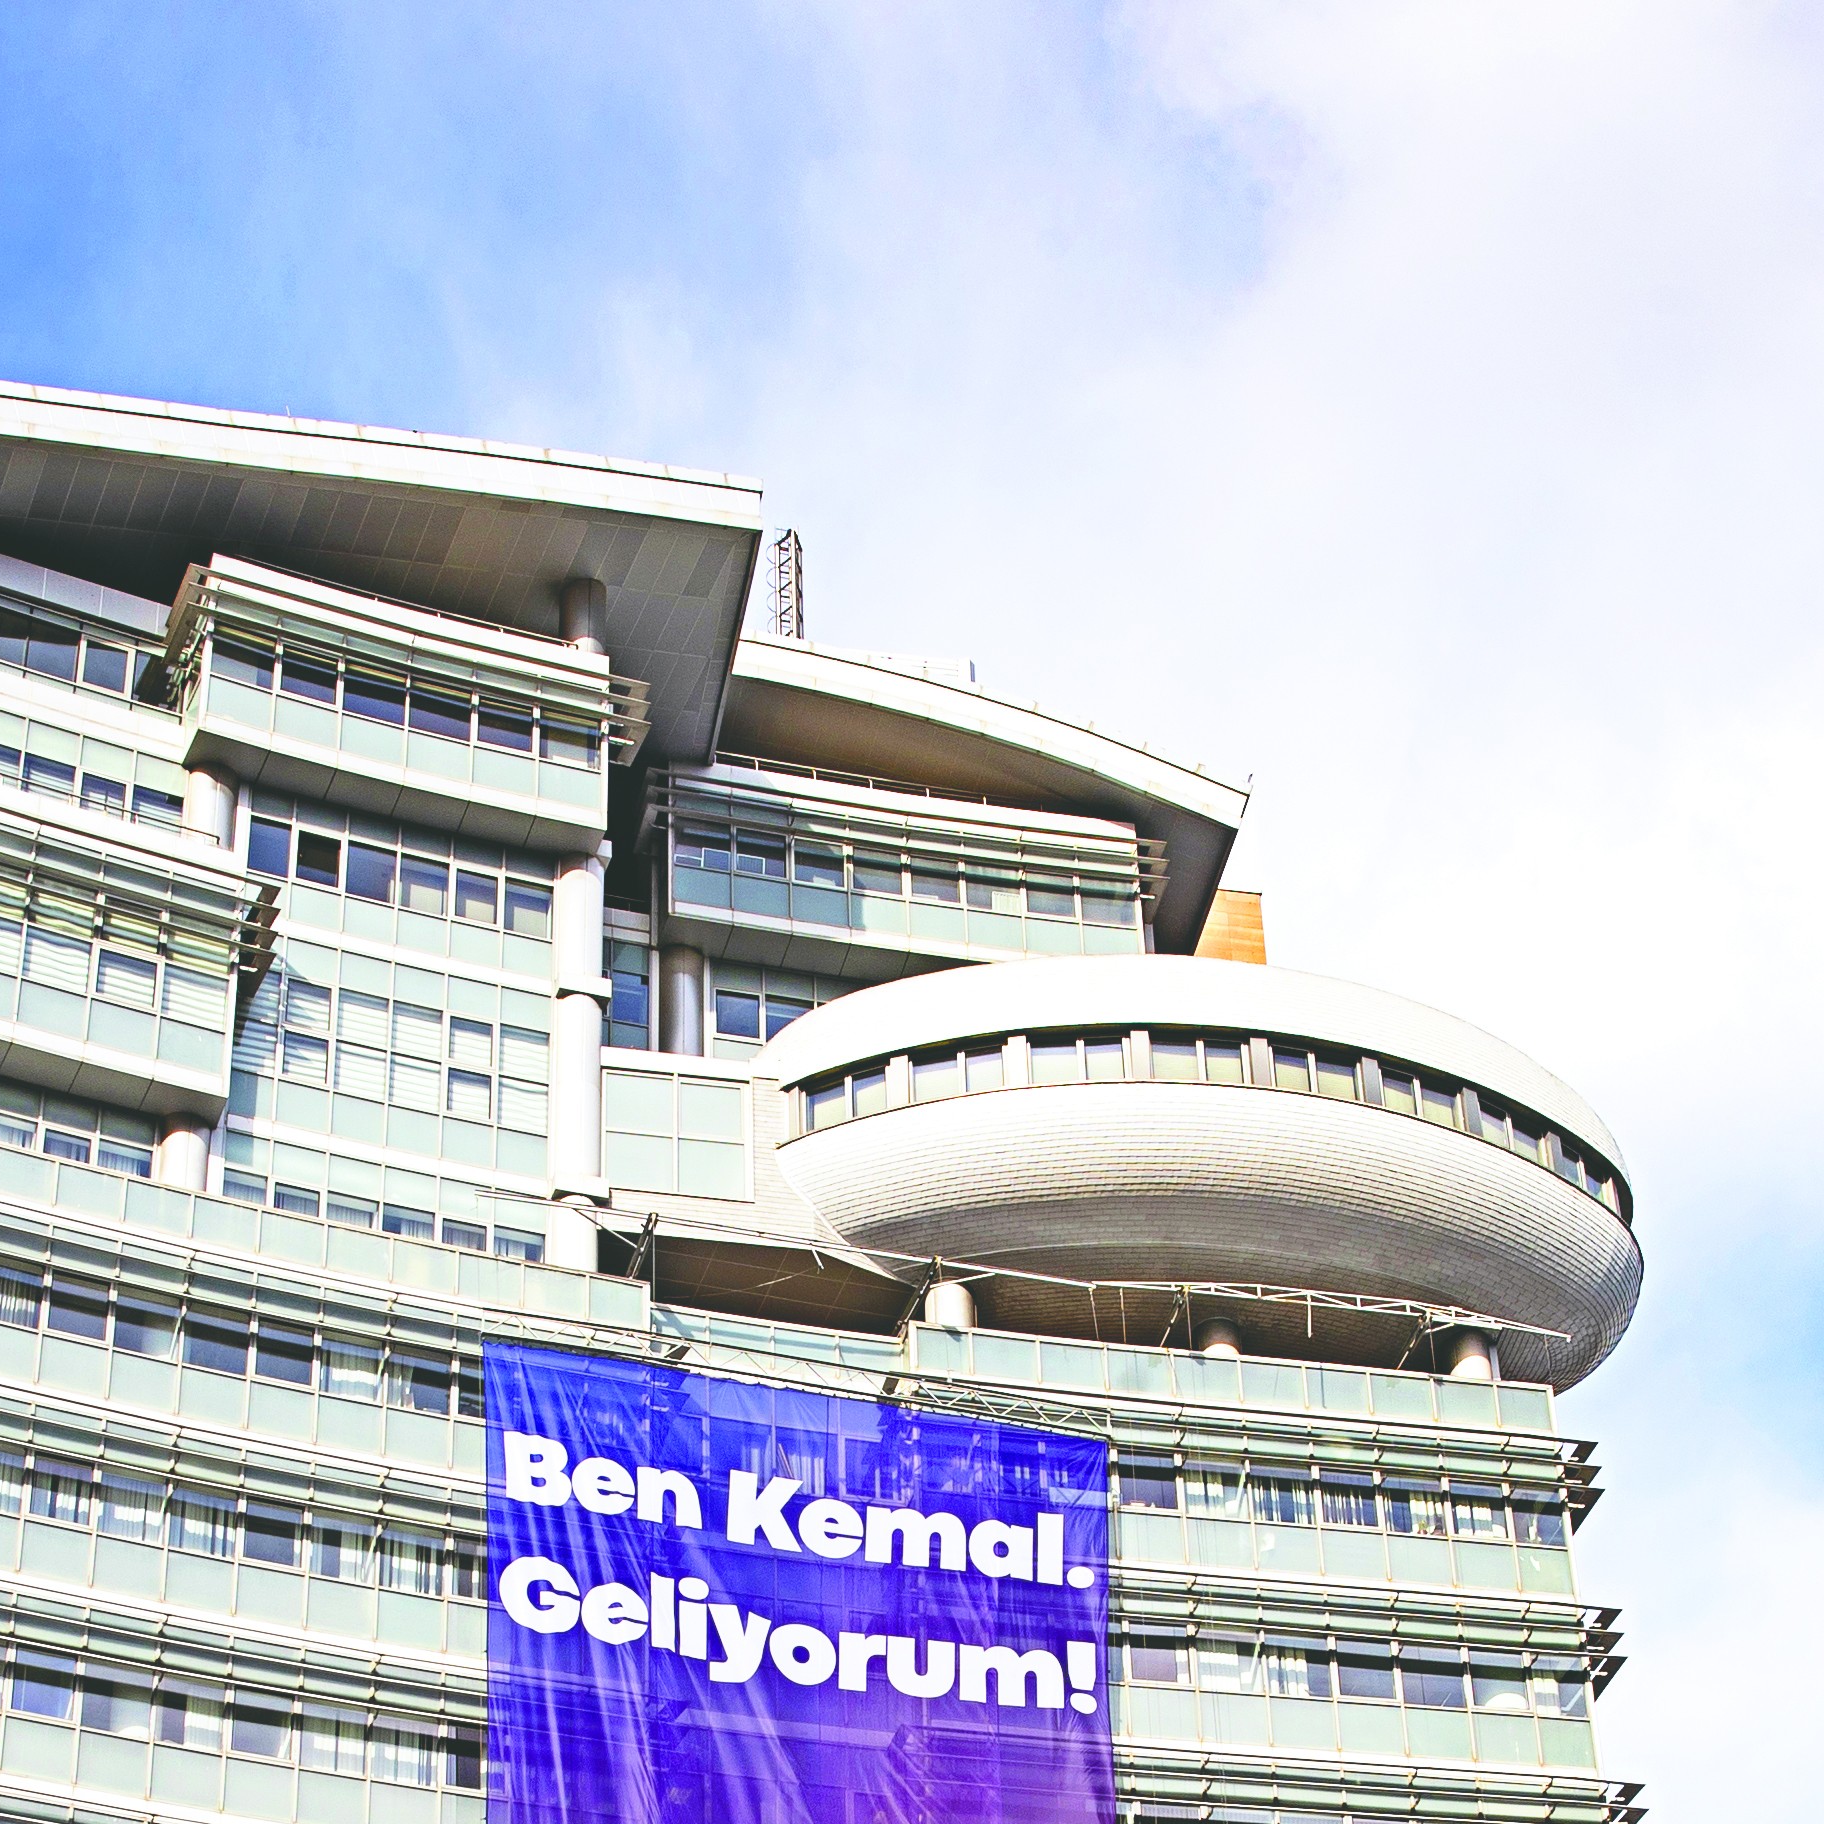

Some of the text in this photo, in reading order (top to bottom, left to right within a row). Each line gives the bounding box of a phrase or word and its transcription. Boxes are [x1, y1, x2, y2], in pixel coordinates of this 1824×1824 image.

[503, 1430, 1095, 1589] Ben Kemal.
[498, 1556, 1098, 1715] Geliyorum!
